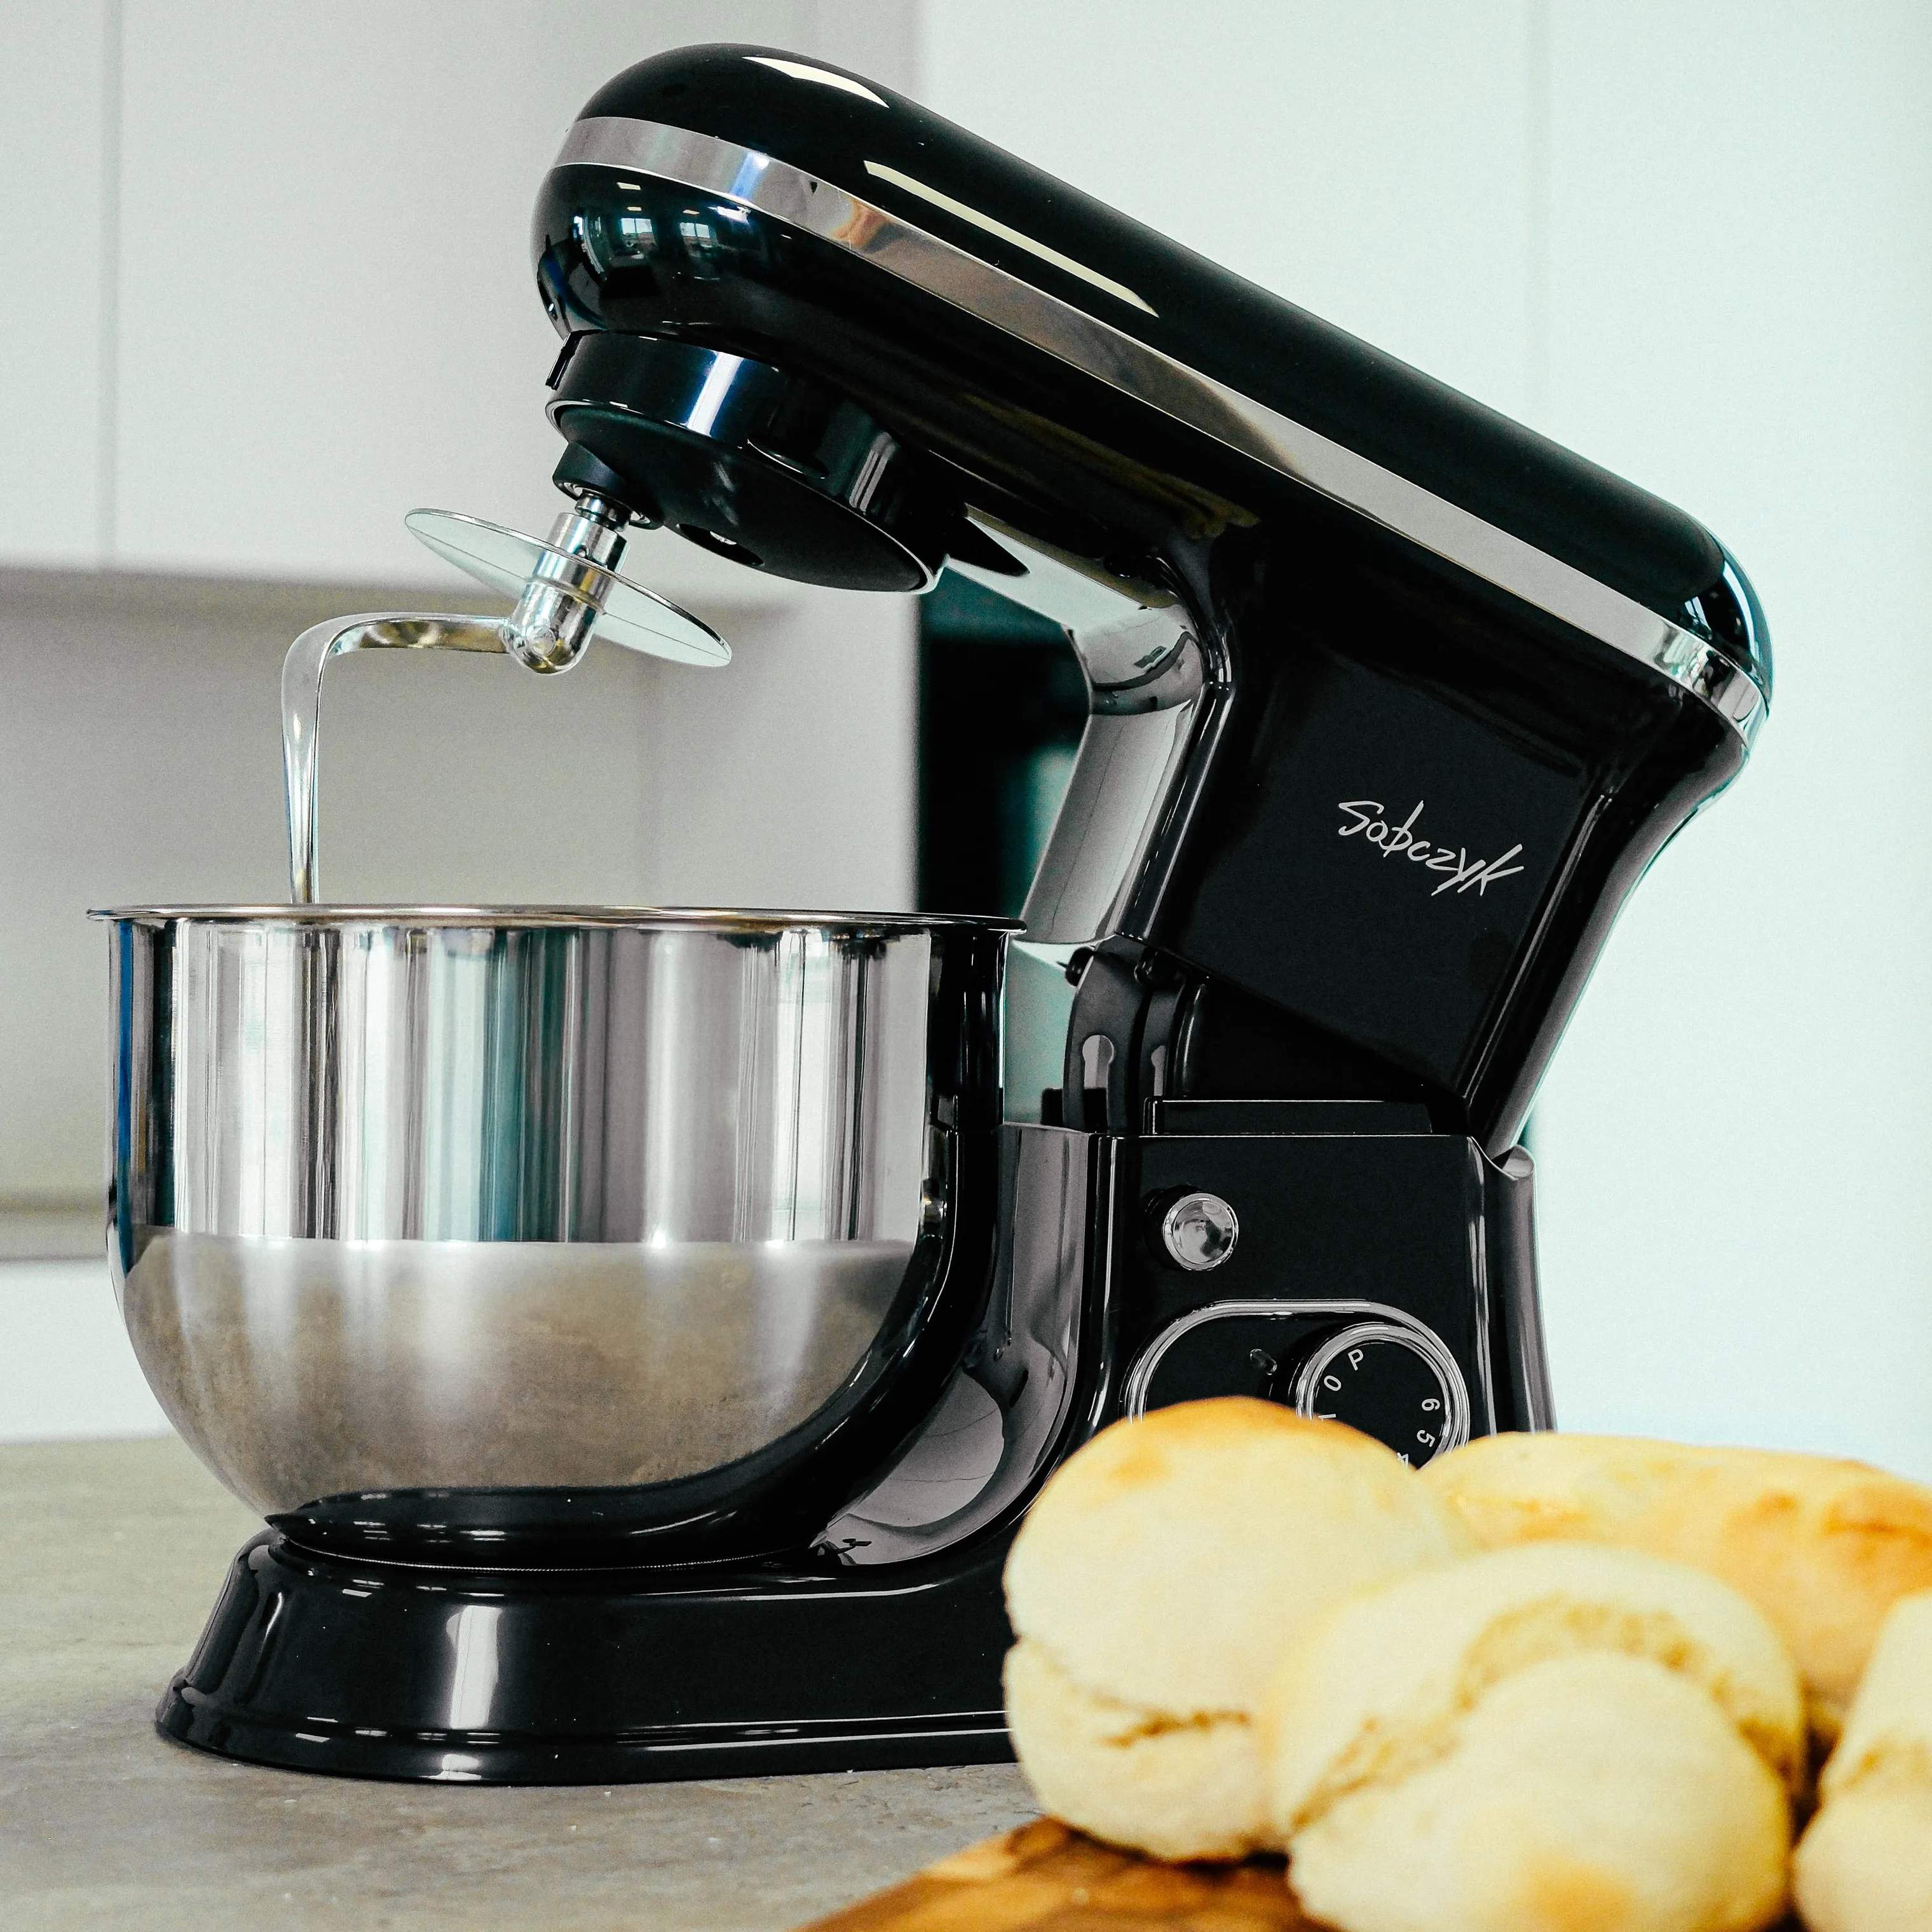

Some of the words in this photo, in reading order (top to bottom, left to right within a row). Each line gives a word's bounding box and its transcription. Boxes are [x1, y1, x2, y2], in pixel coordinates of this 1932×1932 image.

[1348, 1349, 1364, 1371] P
[1422, 1398, 1441, 1411] 6
[1417, 1429, 1436, 1448] 5
